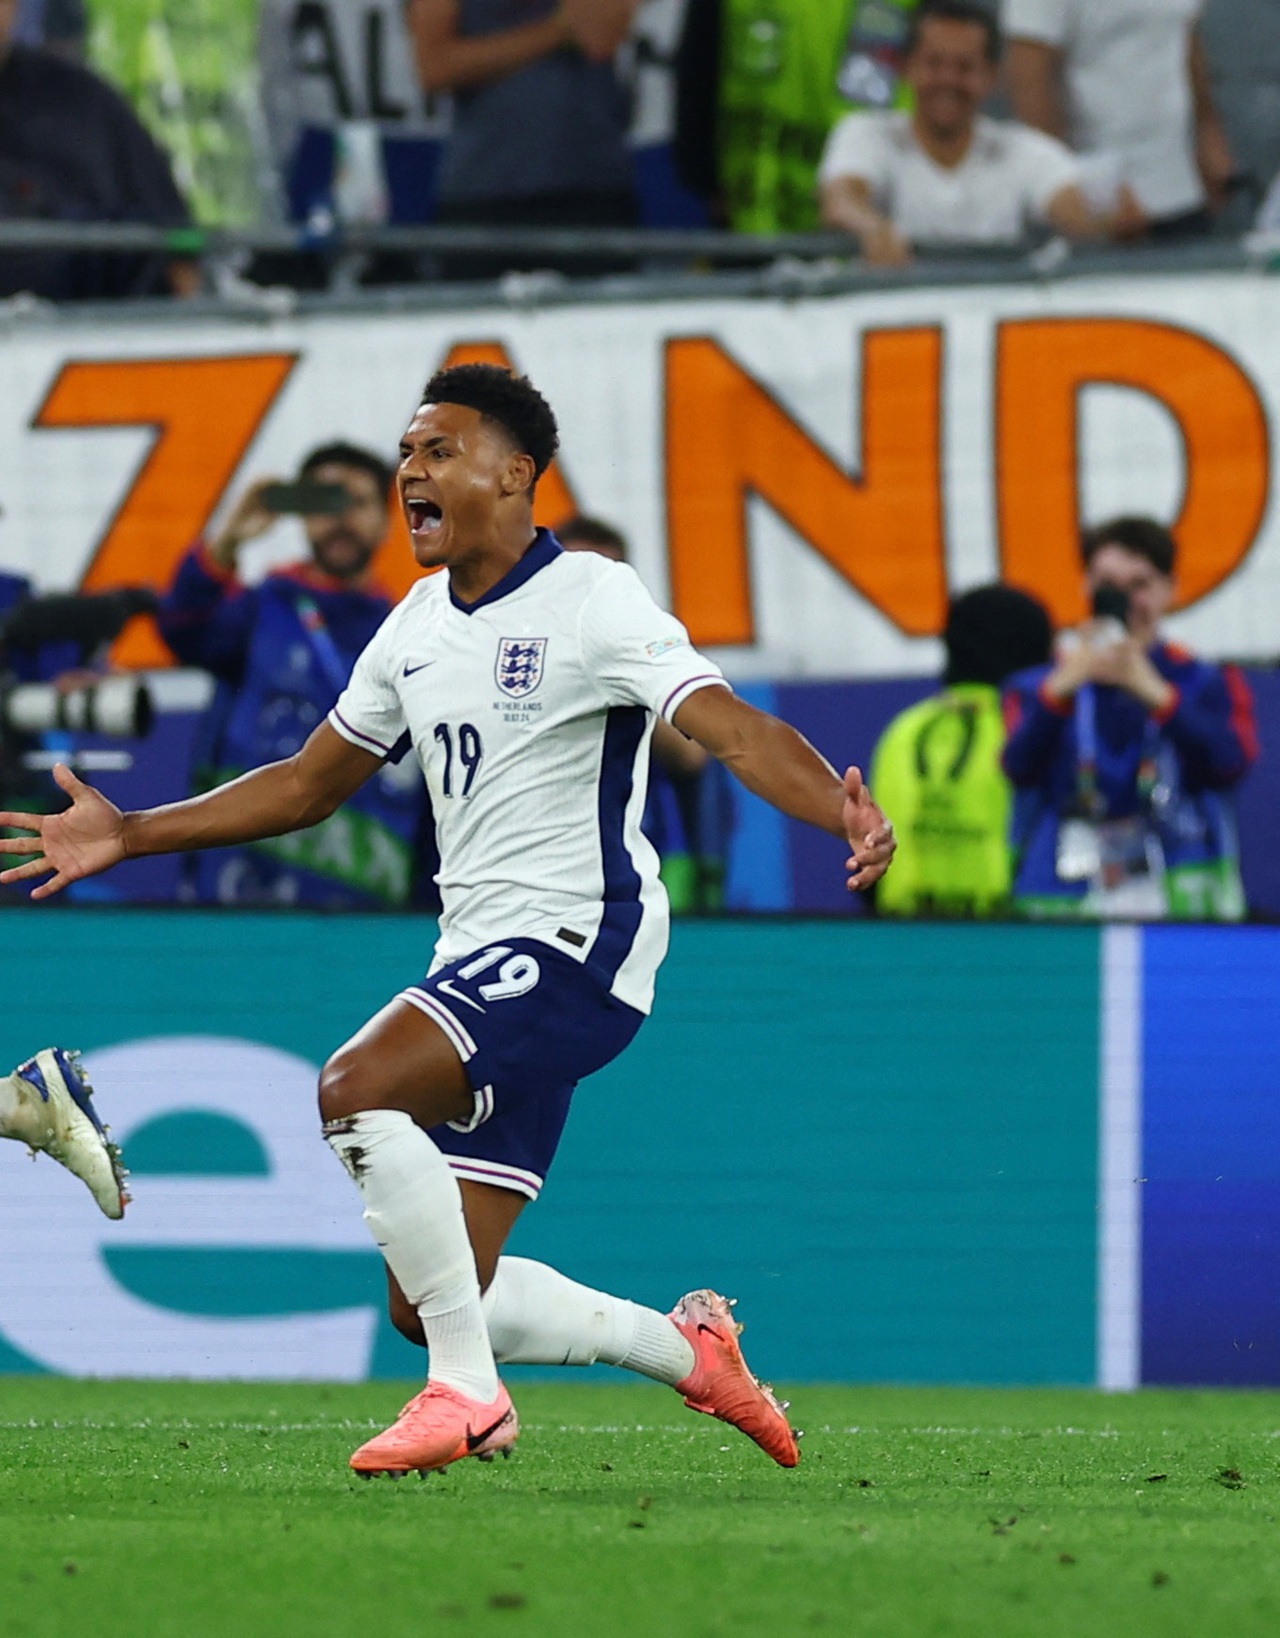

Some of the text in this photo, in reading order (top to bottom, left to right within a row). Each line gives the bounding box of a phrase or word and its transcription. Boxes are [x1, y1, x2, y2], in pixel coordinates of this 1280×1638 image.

[492, 702, 542, 711] NETHERLANDS
[433, 722, 483, 800] 19
[457, 946, 540, 1002] 19
